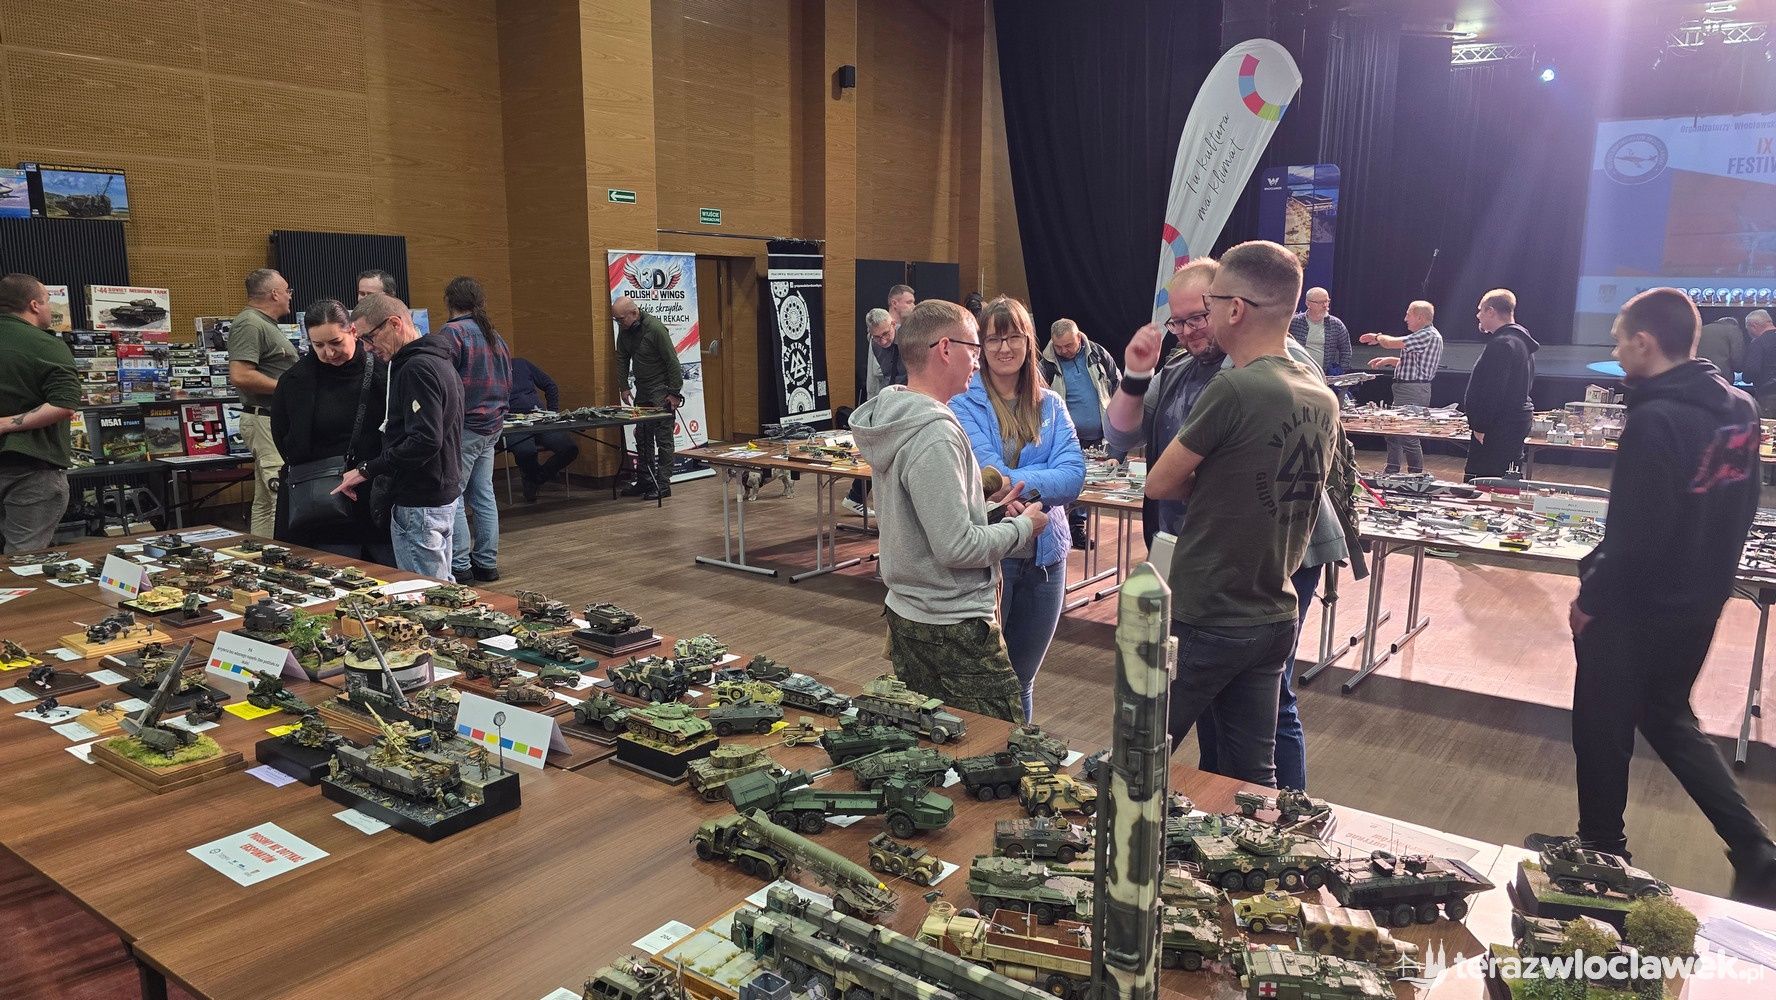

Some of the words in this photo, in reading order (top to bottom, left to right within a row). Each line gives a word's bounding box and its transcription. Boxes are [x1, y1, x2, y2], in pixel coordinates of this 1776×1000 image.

[1184, 172, 1201, 194] Tu
[1195, 113, 1230, 171] kultura
[1757, 137, 1775, 155] IX
[1198, 195, 1212, 222] ma
[1207, 138, 1245, 195] klimat
[641, 268, 666, 290] 3D
[624, 290, 651, 299] POLISH
[660, 290, 685, 299] WINGS
[655, 302, 683, 314] skrzydła
[663, 314, 690, 324] RĘKACH
[100, 418, 122, 428] M5A1
